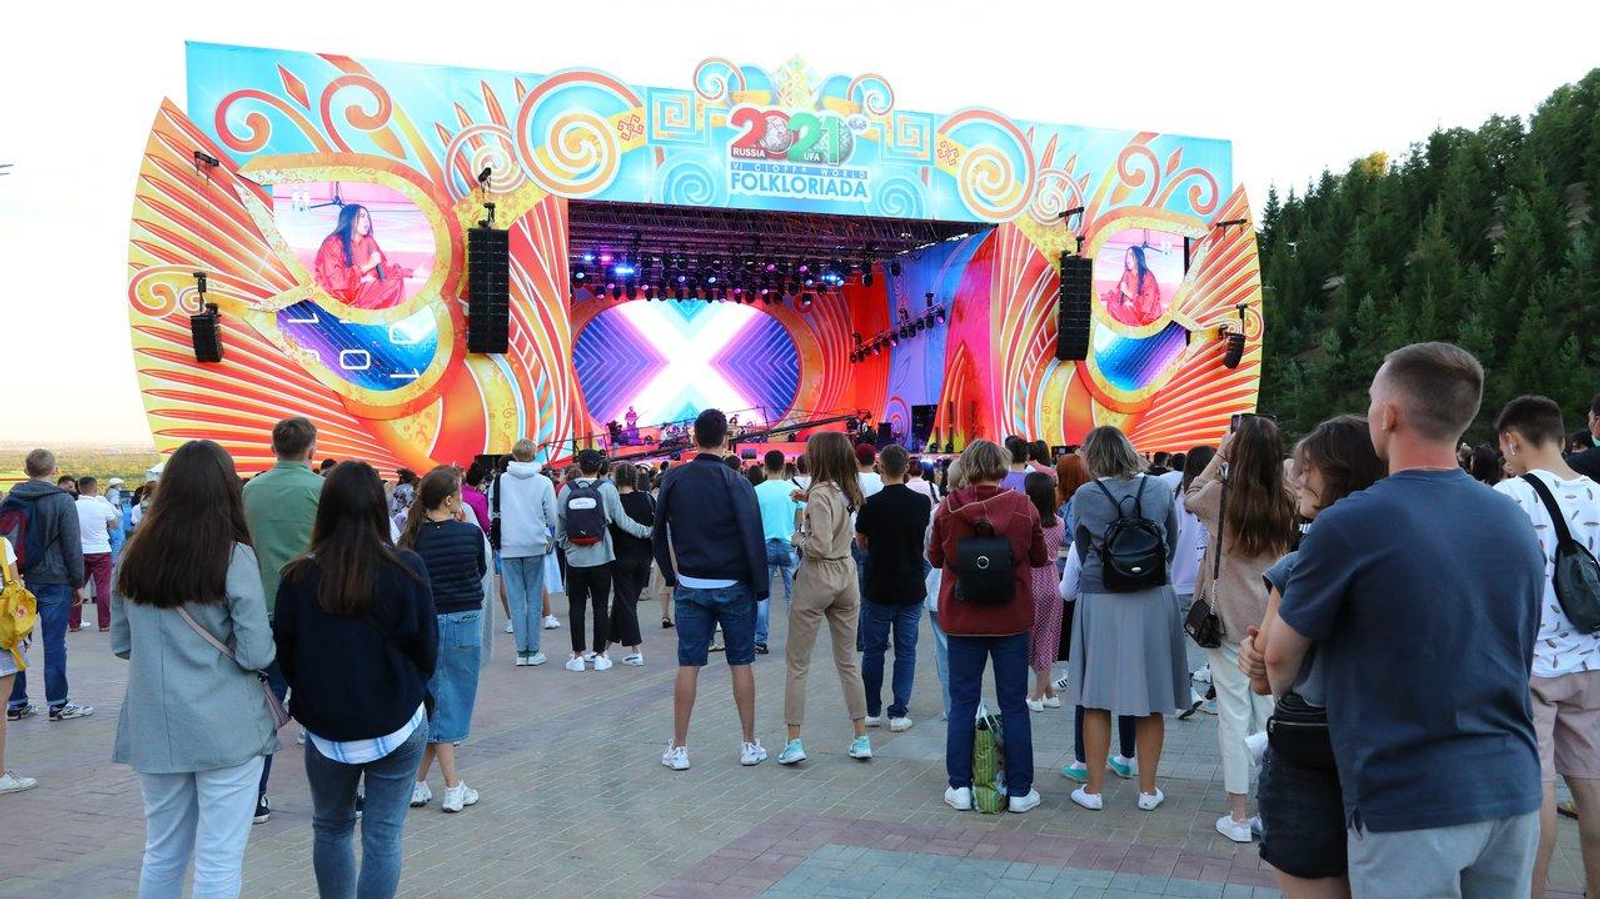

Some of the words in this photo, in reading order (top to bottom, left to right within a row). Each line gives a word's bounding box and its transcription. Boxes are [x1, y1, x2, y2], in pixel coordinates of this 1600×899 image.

[731, 107, 840, 165] 2021
[733, 147, 766, 158] RUSSIA
[804, 152, 820, 162] UFA
[733, 162, 743, 171] VI
[820, 168, 866, 178] WORLD
[731, 172, 867, 197] FOLKLORIADA
